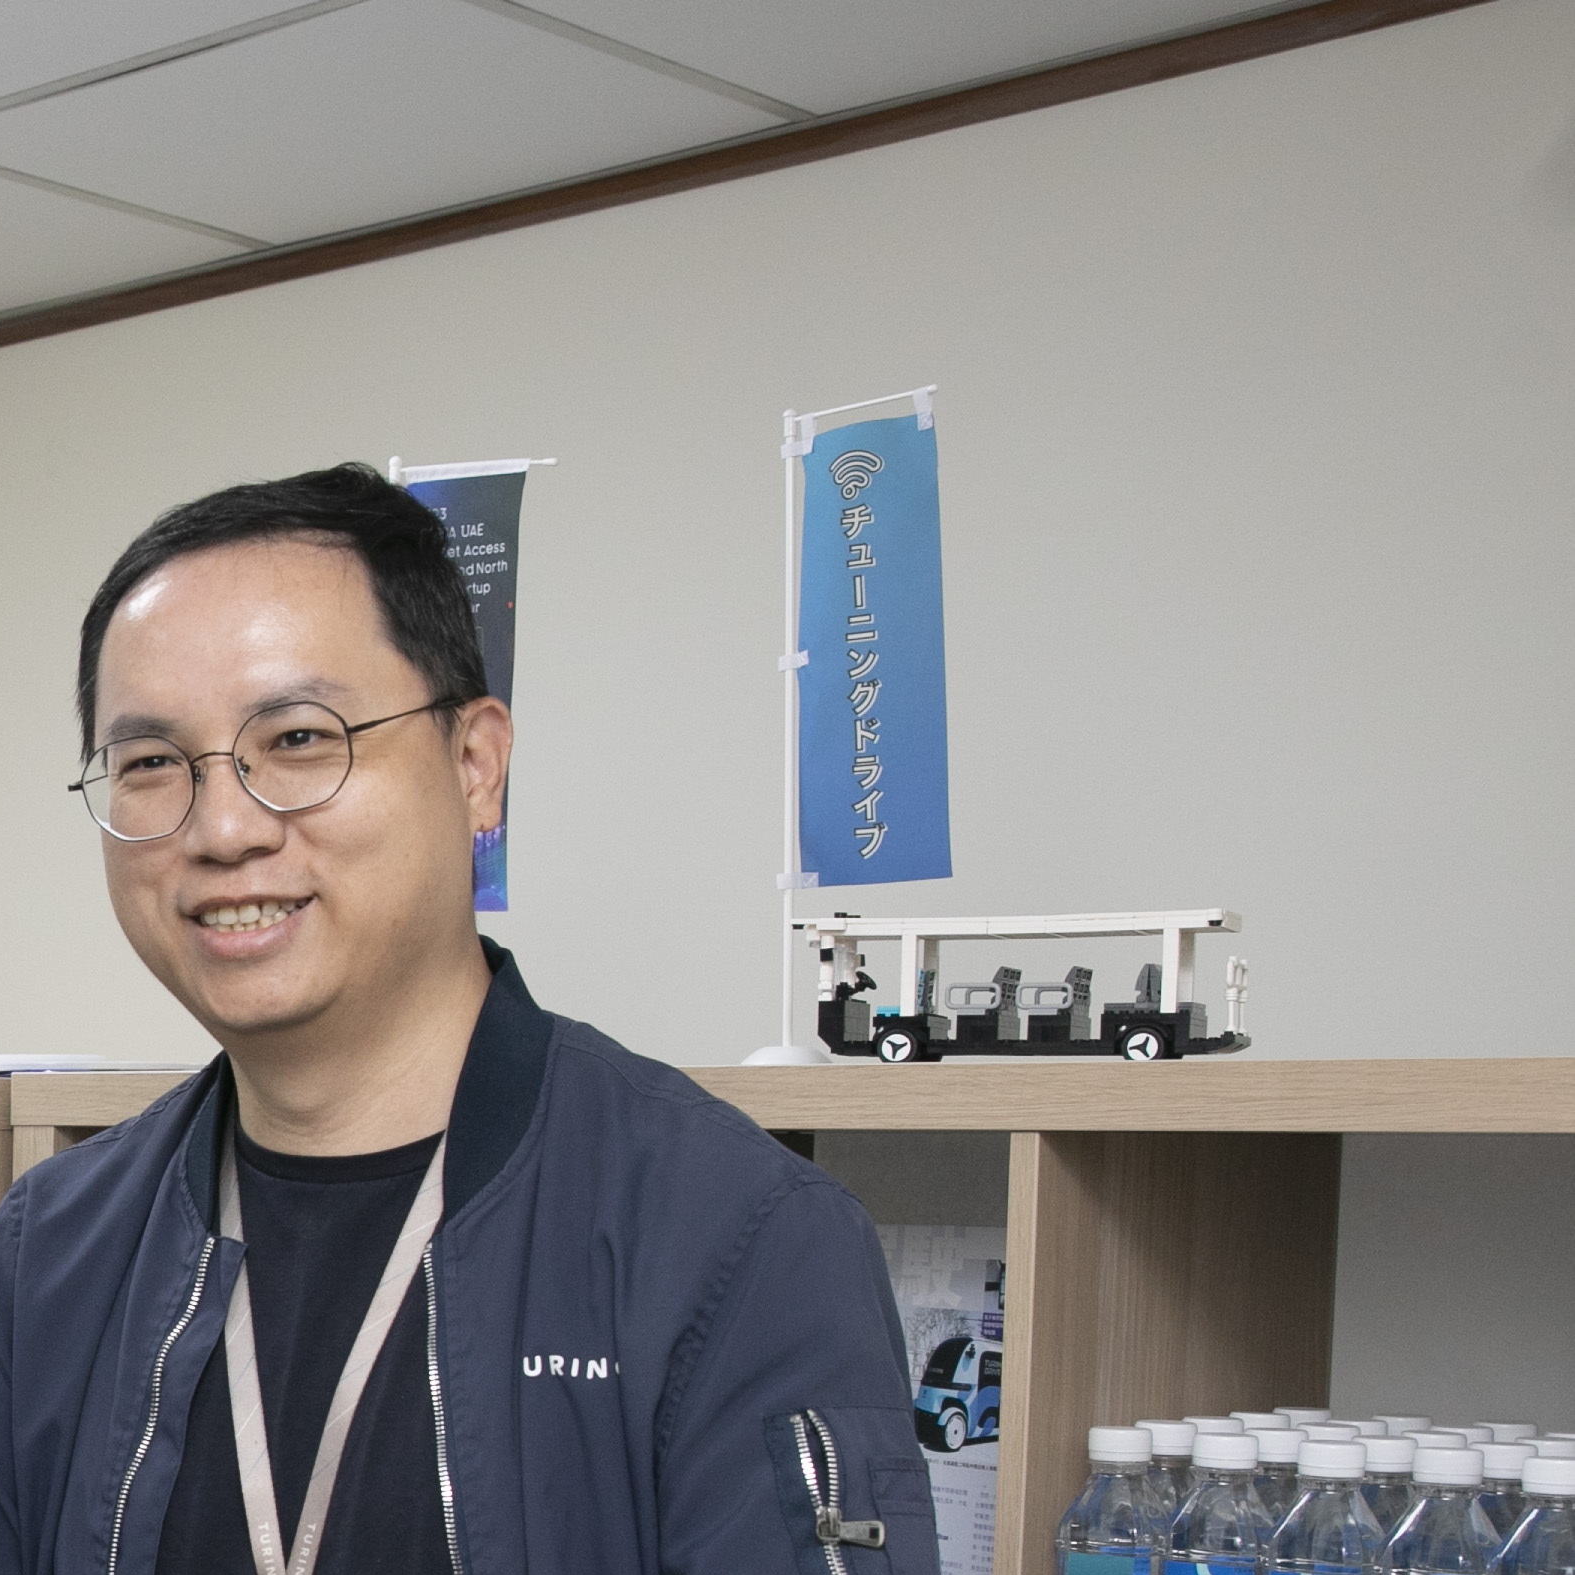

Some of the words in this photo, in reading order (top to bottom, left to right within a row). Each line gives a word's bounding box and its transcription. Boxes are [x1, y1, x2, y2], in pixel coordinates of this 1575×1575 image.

[461, 523, 484, 538] UAE
[464, 543, 506, 557] Access
[476, 560, 508, 575] North
[523, 1355, 620, 1379] URIN
